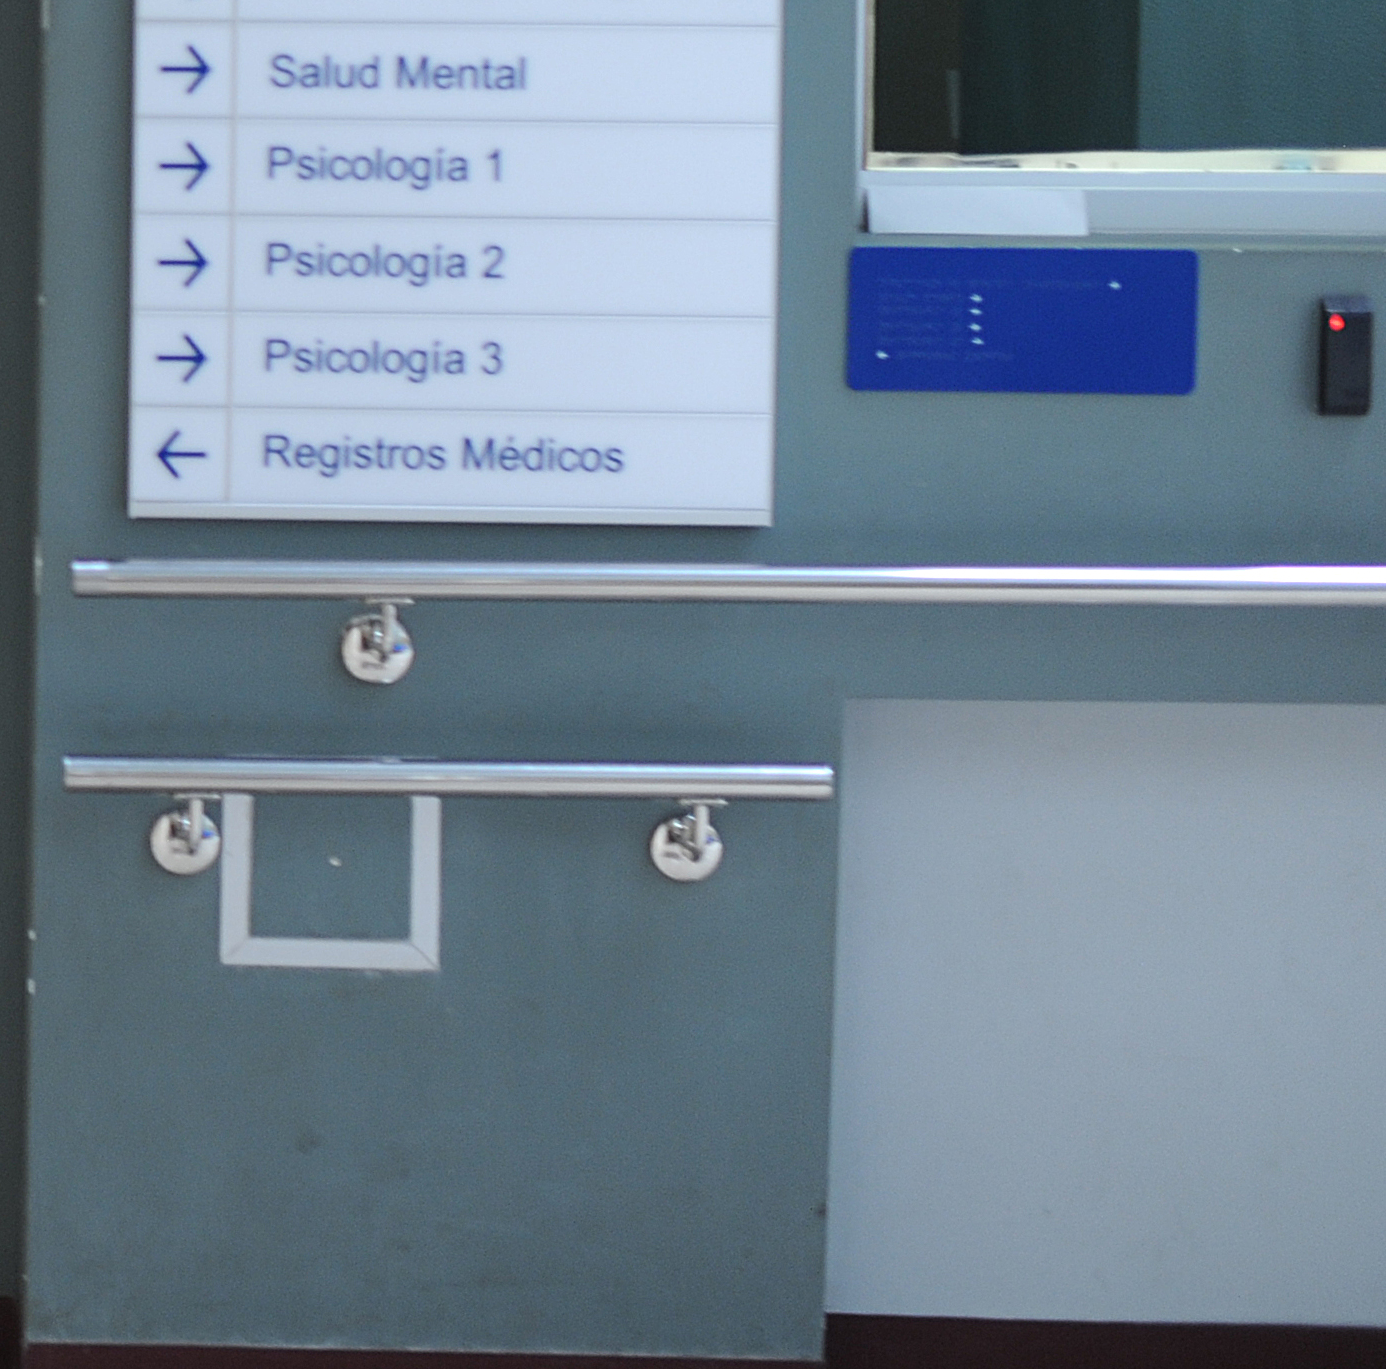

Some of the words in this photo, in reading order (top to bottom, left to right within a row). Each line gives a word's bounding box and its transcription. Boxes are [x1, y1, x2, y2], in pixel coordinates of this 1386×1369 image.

[269, 53, 381, 90] Salud
[395, 56, 527, 91] Mental
[486, 148, 502, 182] 1
[481, 244, 505, 280] 2
[480, 340, 504, 376] 3
[262, 433, 447, 479] Registros
[461, 434, 625, 474] Médicos
